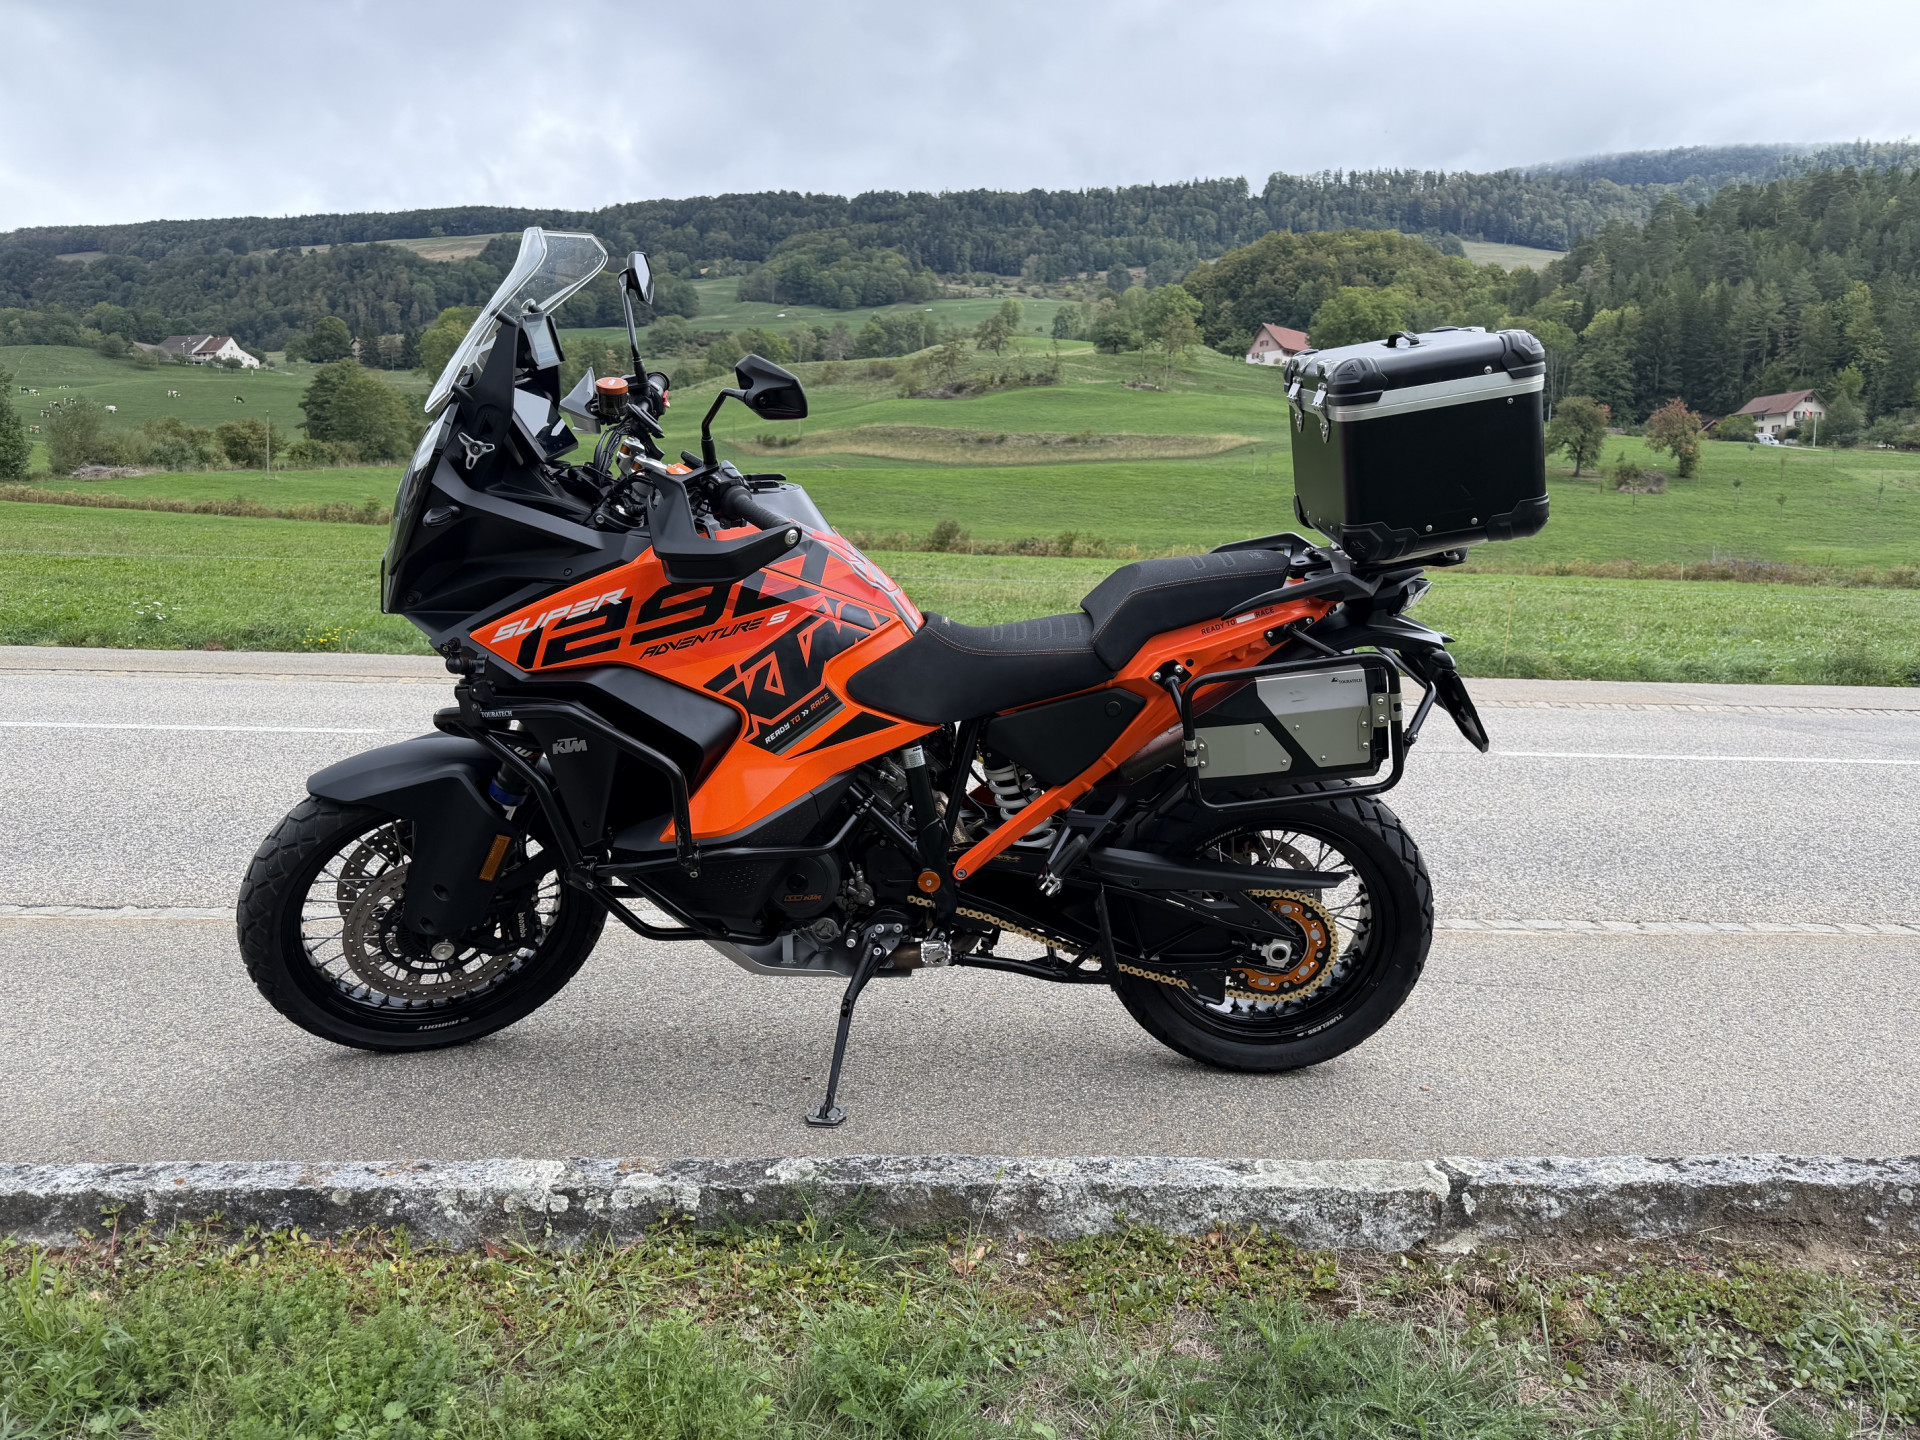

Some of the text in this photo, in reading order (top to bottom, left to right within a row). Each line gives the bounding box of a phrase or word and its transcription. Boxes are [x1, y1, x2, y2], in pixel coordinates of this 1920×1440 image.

[490, 587, 627, 644] SUPER
[1201, 607, 1275, 636] READY TO RACE
[638, 609, 791, 660] ADVENTURE S
[480, 710, 513, 718] TOURATECH
[764, 692, 831, 745] READY TO RACE
[552, 737, 588, 755] KTM
[518, 911, 527, 937] brembo
